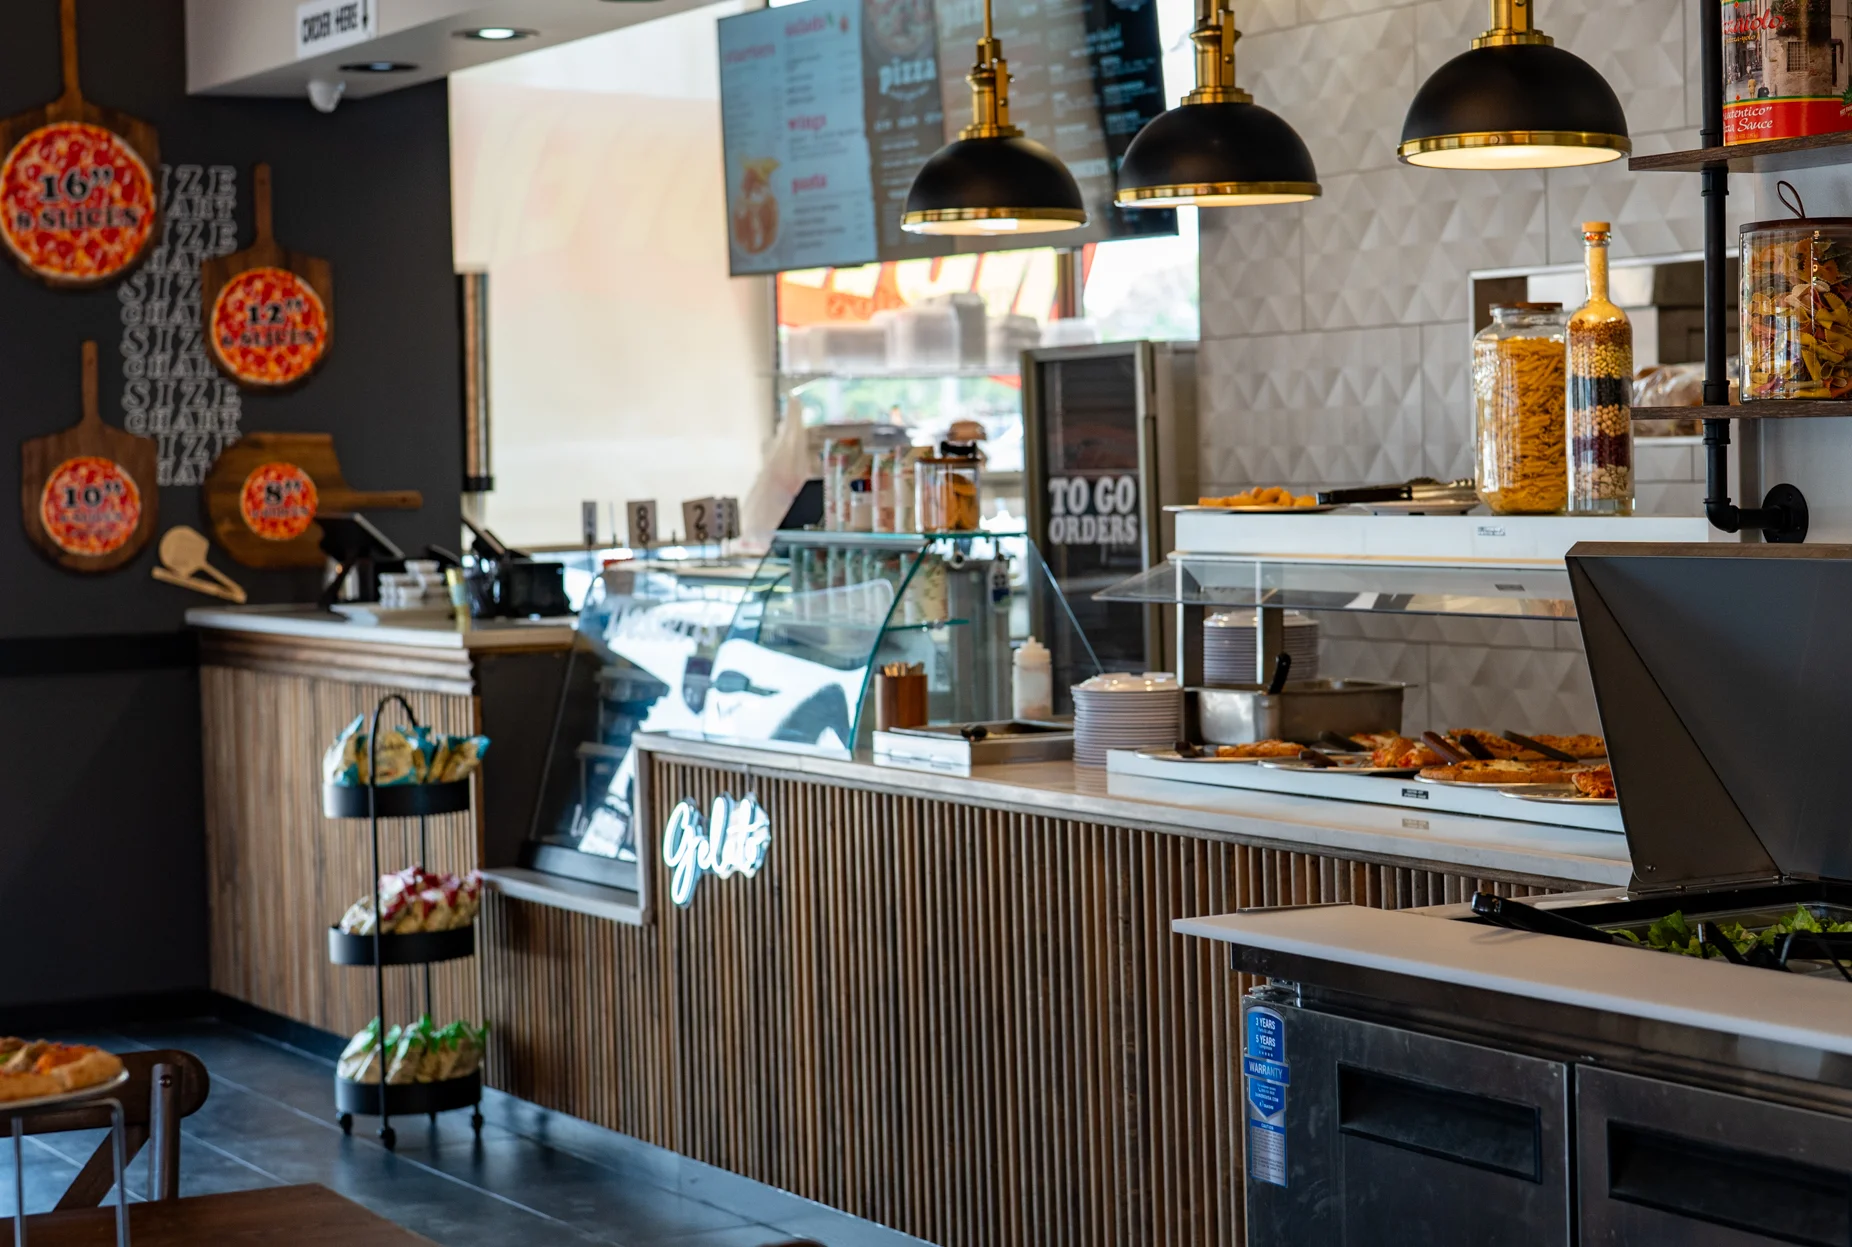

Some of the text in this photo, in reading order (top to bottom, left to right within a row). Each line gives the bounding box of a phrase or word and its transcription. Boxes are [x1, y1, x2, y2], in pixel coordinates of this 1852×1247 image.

[878, 56, 937, 95] pizza
[1737, 117, 1773, 132] Sauce
[117, 270, 203, 303] SIZ
[120, 323, 206, 358] SIZ
[1048, 475, 1138, 516] TO GO
[1048, 514, 1139, 545] ORDERS
[1255, 1016, 1276, 1030] 3 YEARS
[1255, 1034, 1260, 1043] 5
[1259, 1034, 1276, 1047] YEARS
[1248, 1060, 1283, 1080] WARRANTY
